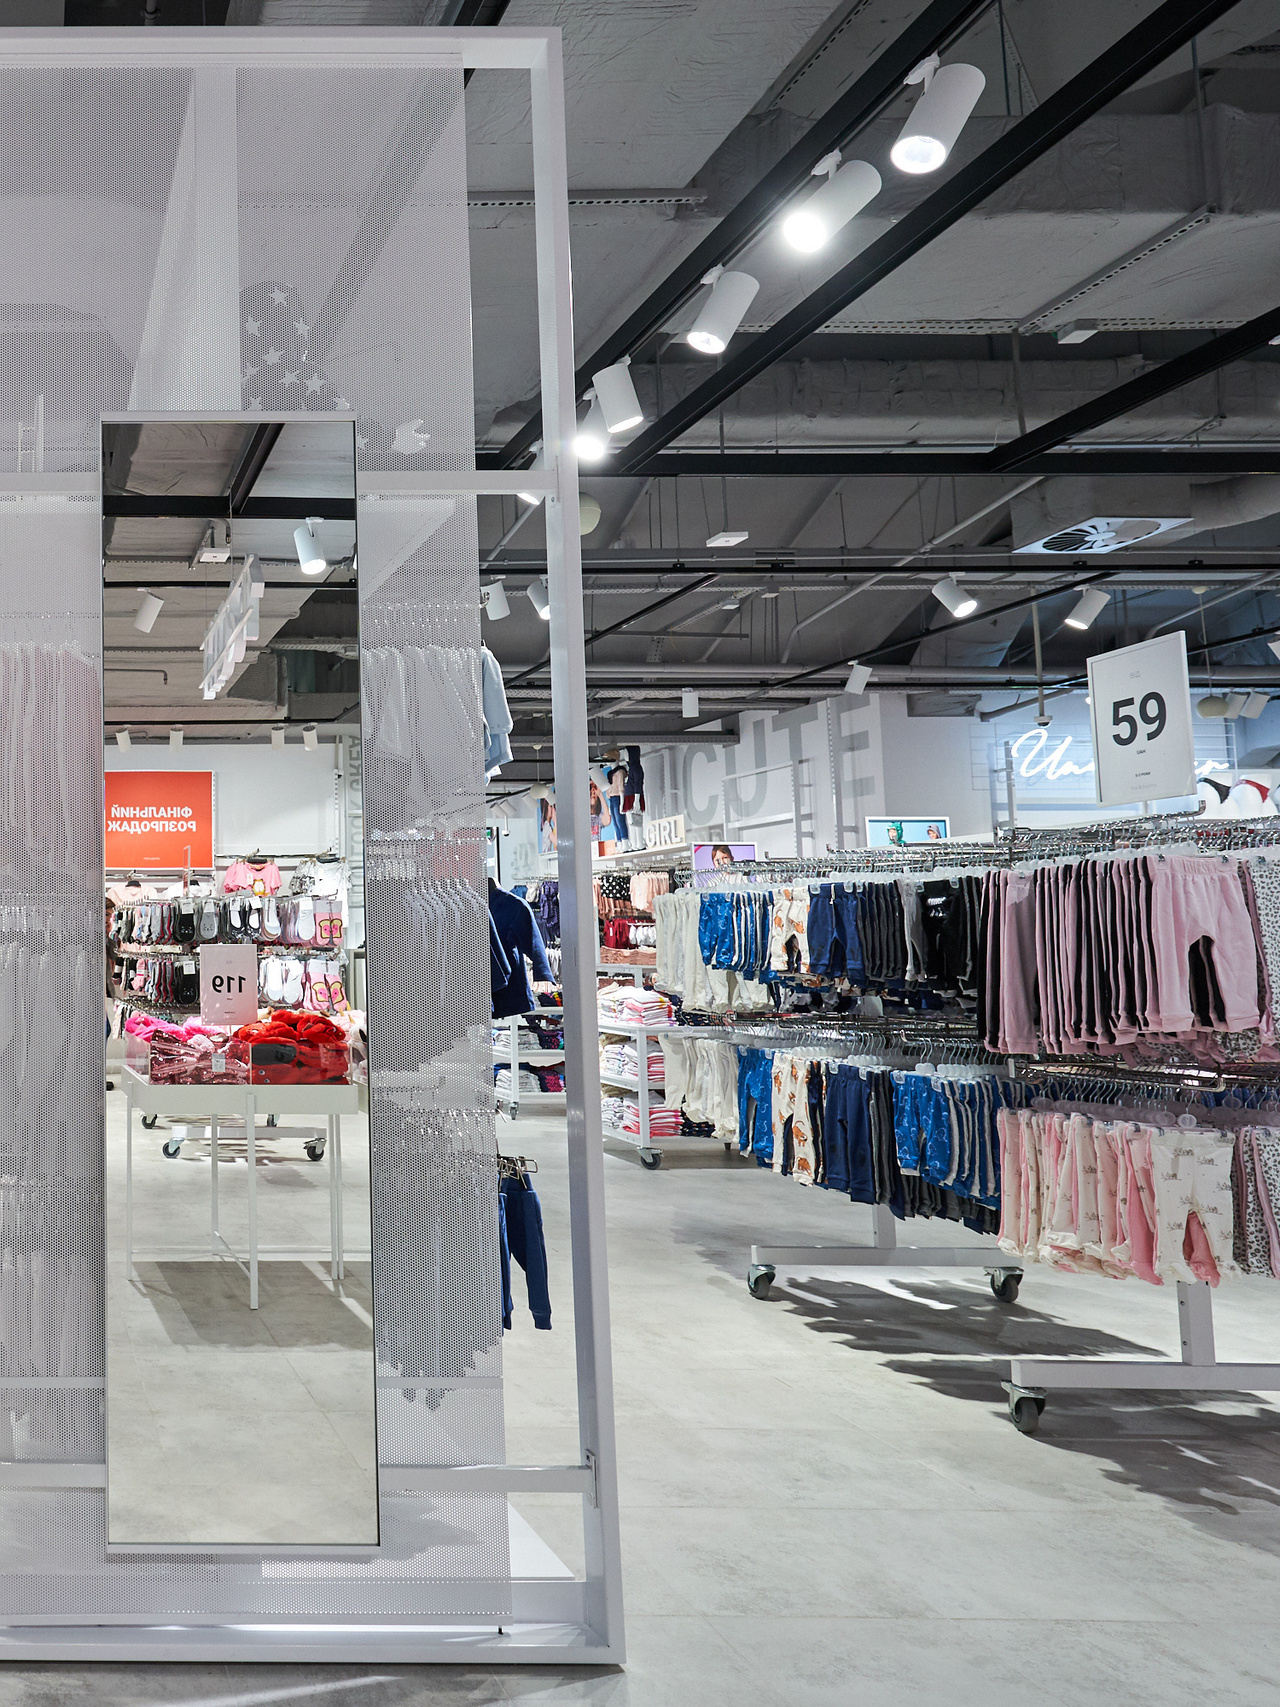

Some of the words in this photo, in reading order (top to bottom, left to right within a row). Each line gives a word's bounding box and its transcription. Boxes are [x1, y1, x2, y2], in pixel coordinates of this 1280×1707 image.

[1112, 691, 1167, 746] 59
[683, 692, 876, 826] CUTE
[646, 819, 681, 848] GIRL
